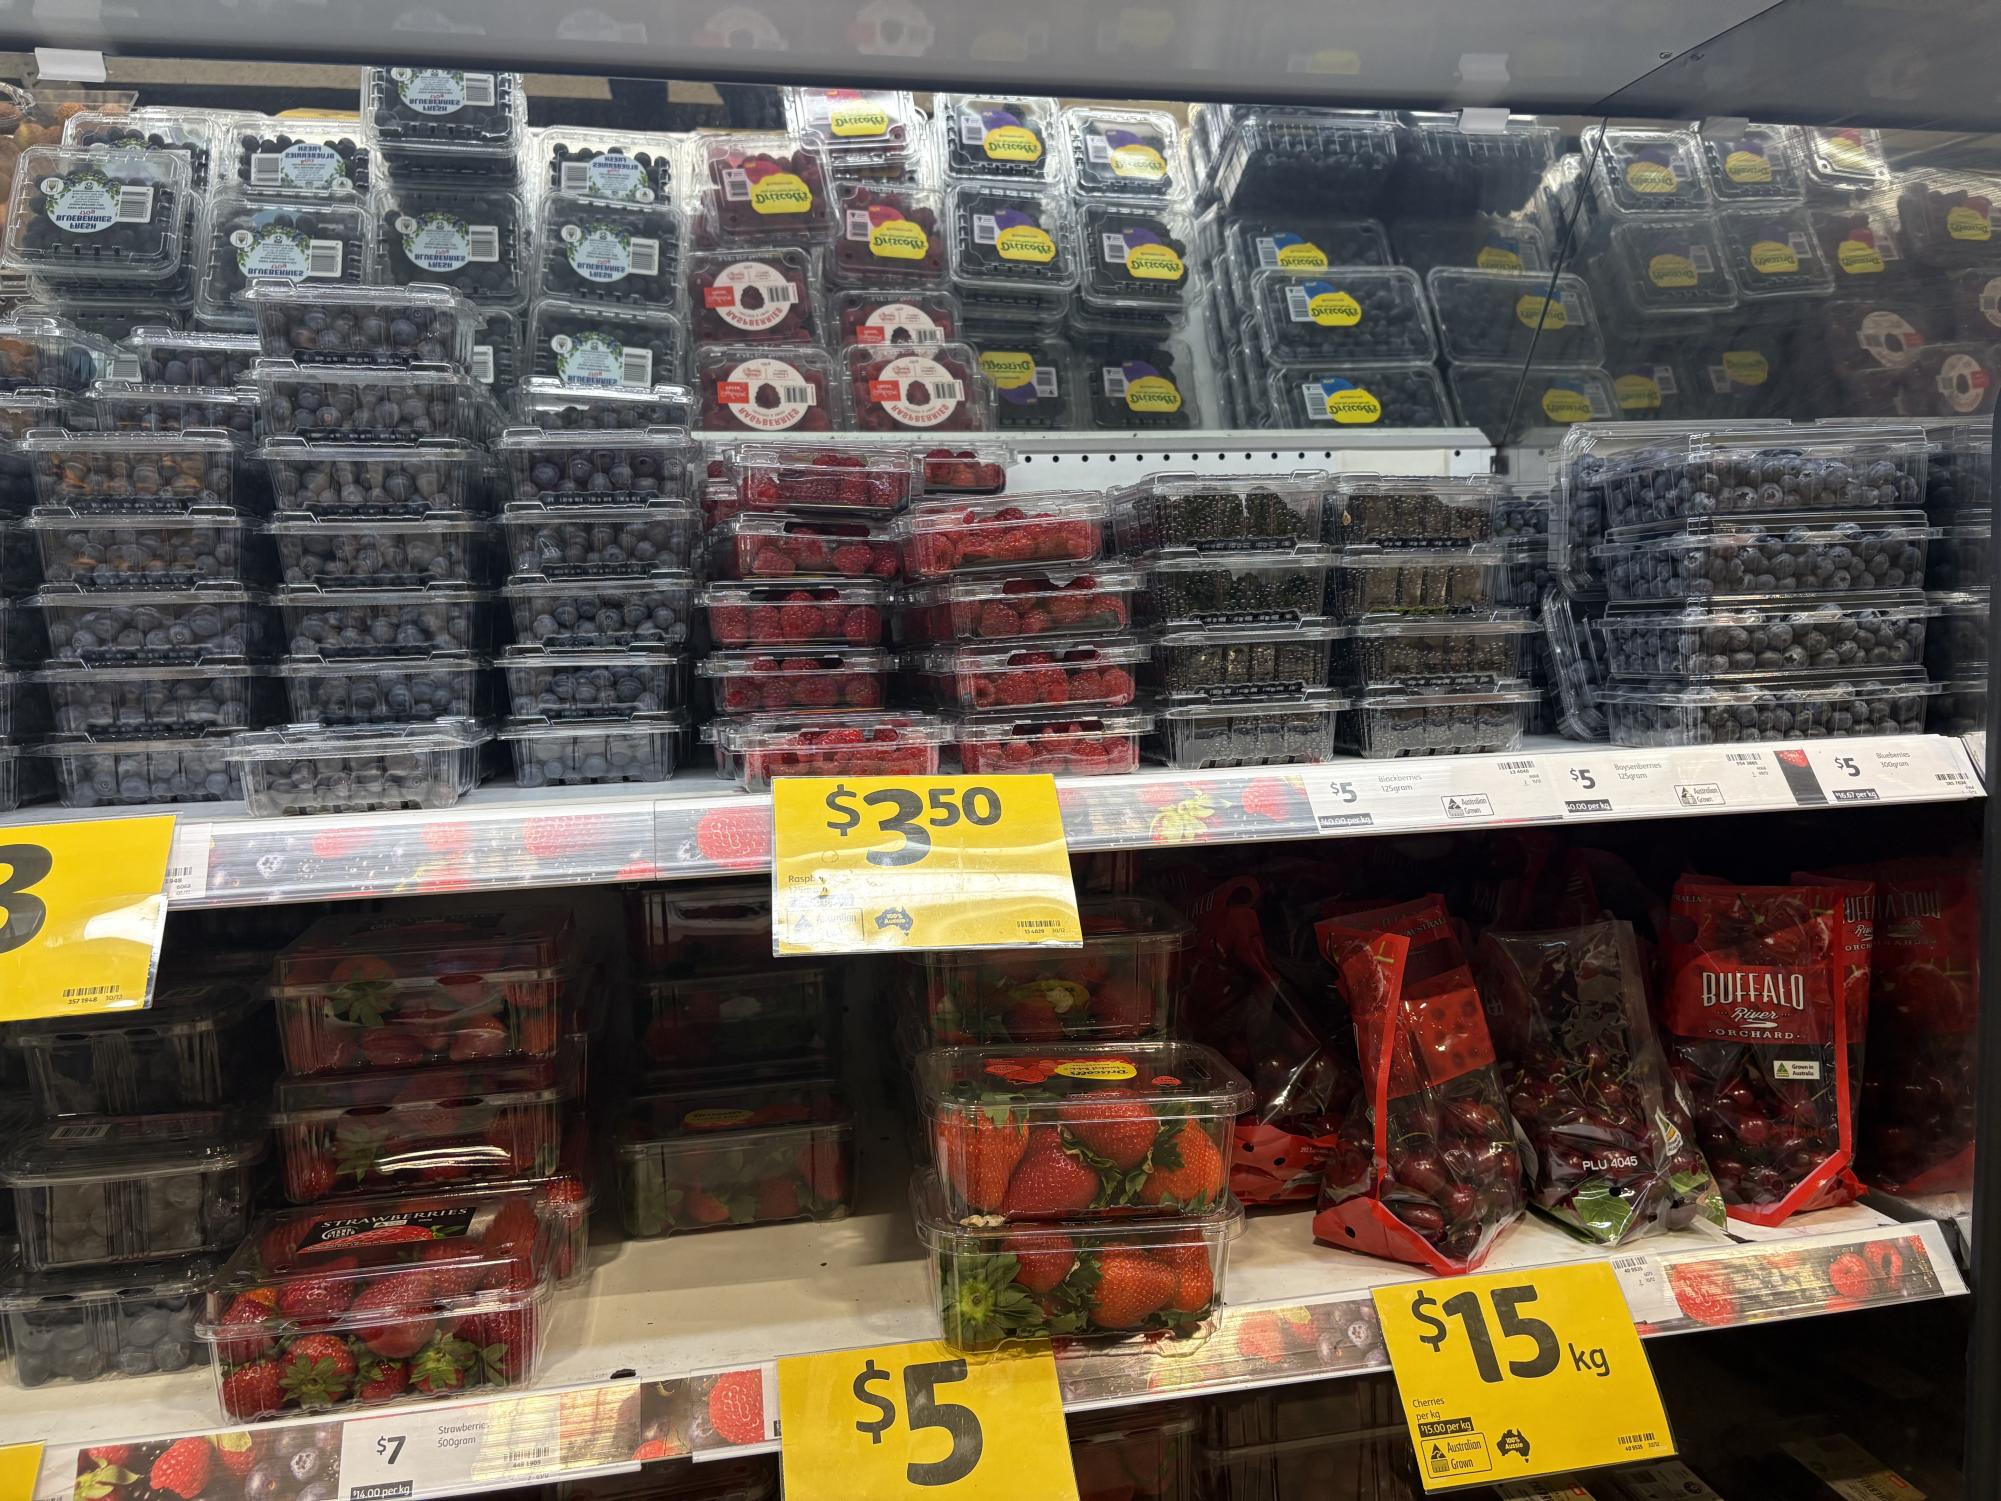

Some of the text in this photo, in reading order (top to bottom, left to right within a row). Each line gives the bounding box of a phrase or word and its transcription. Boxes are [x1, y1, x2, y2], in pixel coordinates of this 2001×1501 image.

[1834, 757, 1861, 777] $5
[1570, 762, 1662, 789] $5 Boysenberries
[1330, 774, 1423, 803] $5 Blackberries
[1381, 784, 1413, 793] 125gram
[1702, 971, 1804, 1010] BUFFALO
[1731, 1008, 1778, 1023] River
[1715, 1028, 1794, 1040] ORCHARD
[1582, 1156, 1638, 1171] PLU 4045
[320, 1208, 468, 1228] STRAWBERRIES
[1411, 1284, 1611, 1383] $15 kg
[1412, 1398, 1445, 1408] Cherries
[853, 1358, 984, 1486] $5
[1416, 1410, 1440, 1422] per kg
[1420, 1420, 1472, 1434] $15.00 per kg
[376, 1436, 406, 1464] $7
[438, 1437, 476, 1448] 500gram
[1448, 1439, 1482, 1453] Australian
[1451, 1458, 1474, 1470] Grown
[353, 1484, 410, 1499] $14.00 per kg
